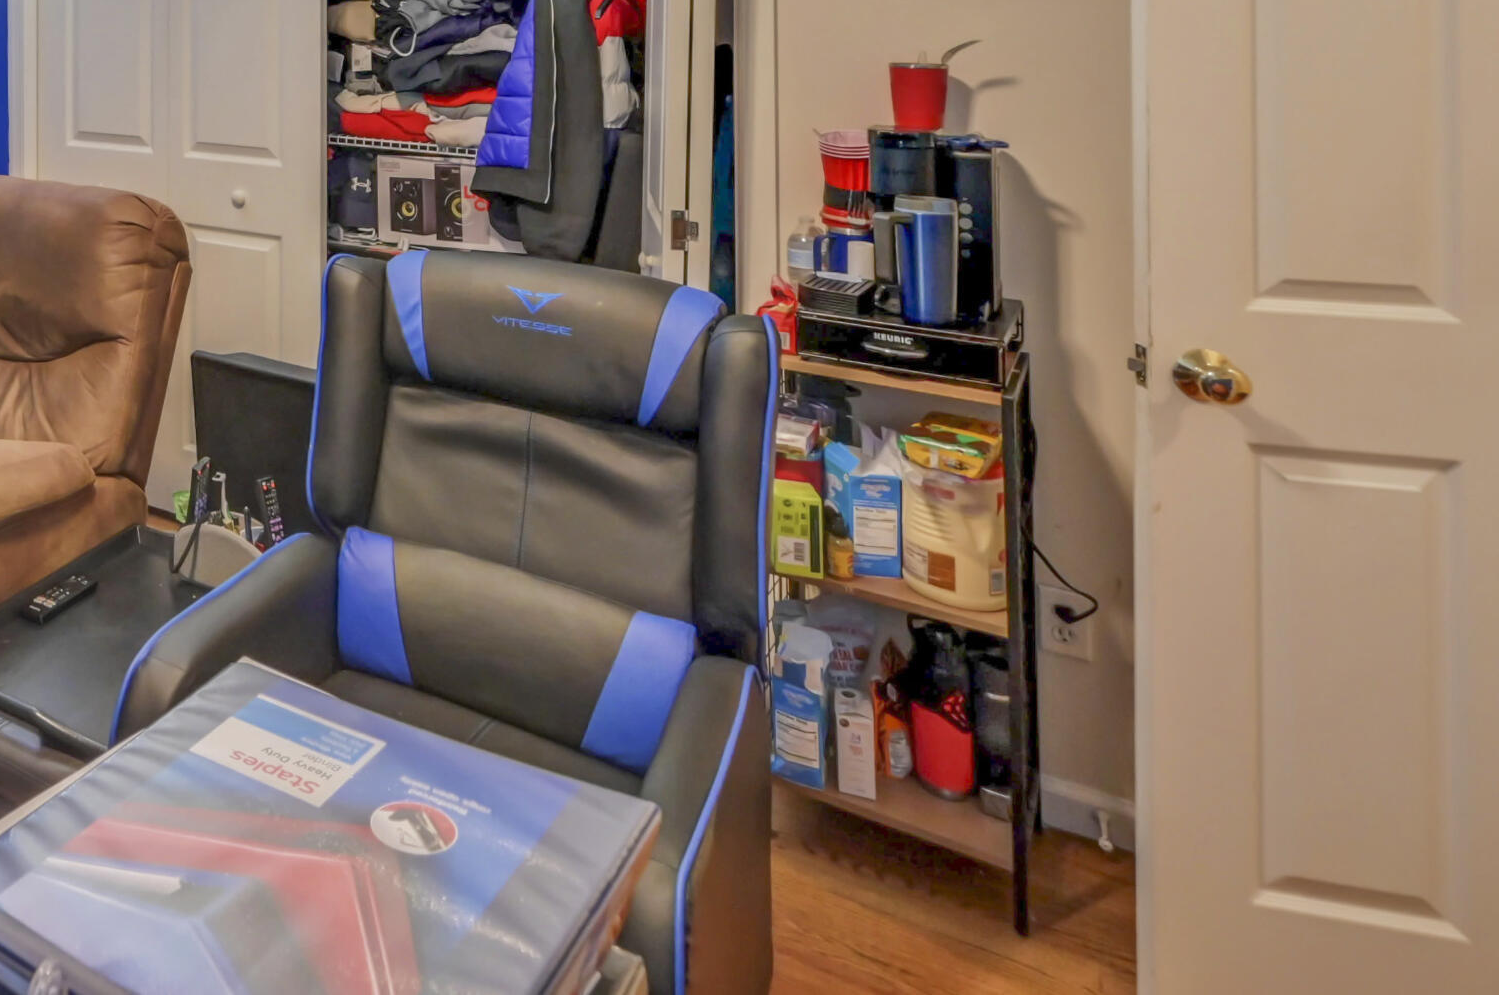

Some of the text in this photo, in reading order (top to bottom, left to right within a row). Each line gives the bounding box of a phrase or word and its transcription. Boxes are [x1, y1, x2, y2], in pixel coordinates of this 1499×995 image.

[491, 315, 573, 337] VITESSE
[873, 331, 914, 345] KEURIG
[229, 749, 321, 795] Staples
[261, 746, 333, 781] Heavy Duty
[302, 753, 342, 773] Binder
